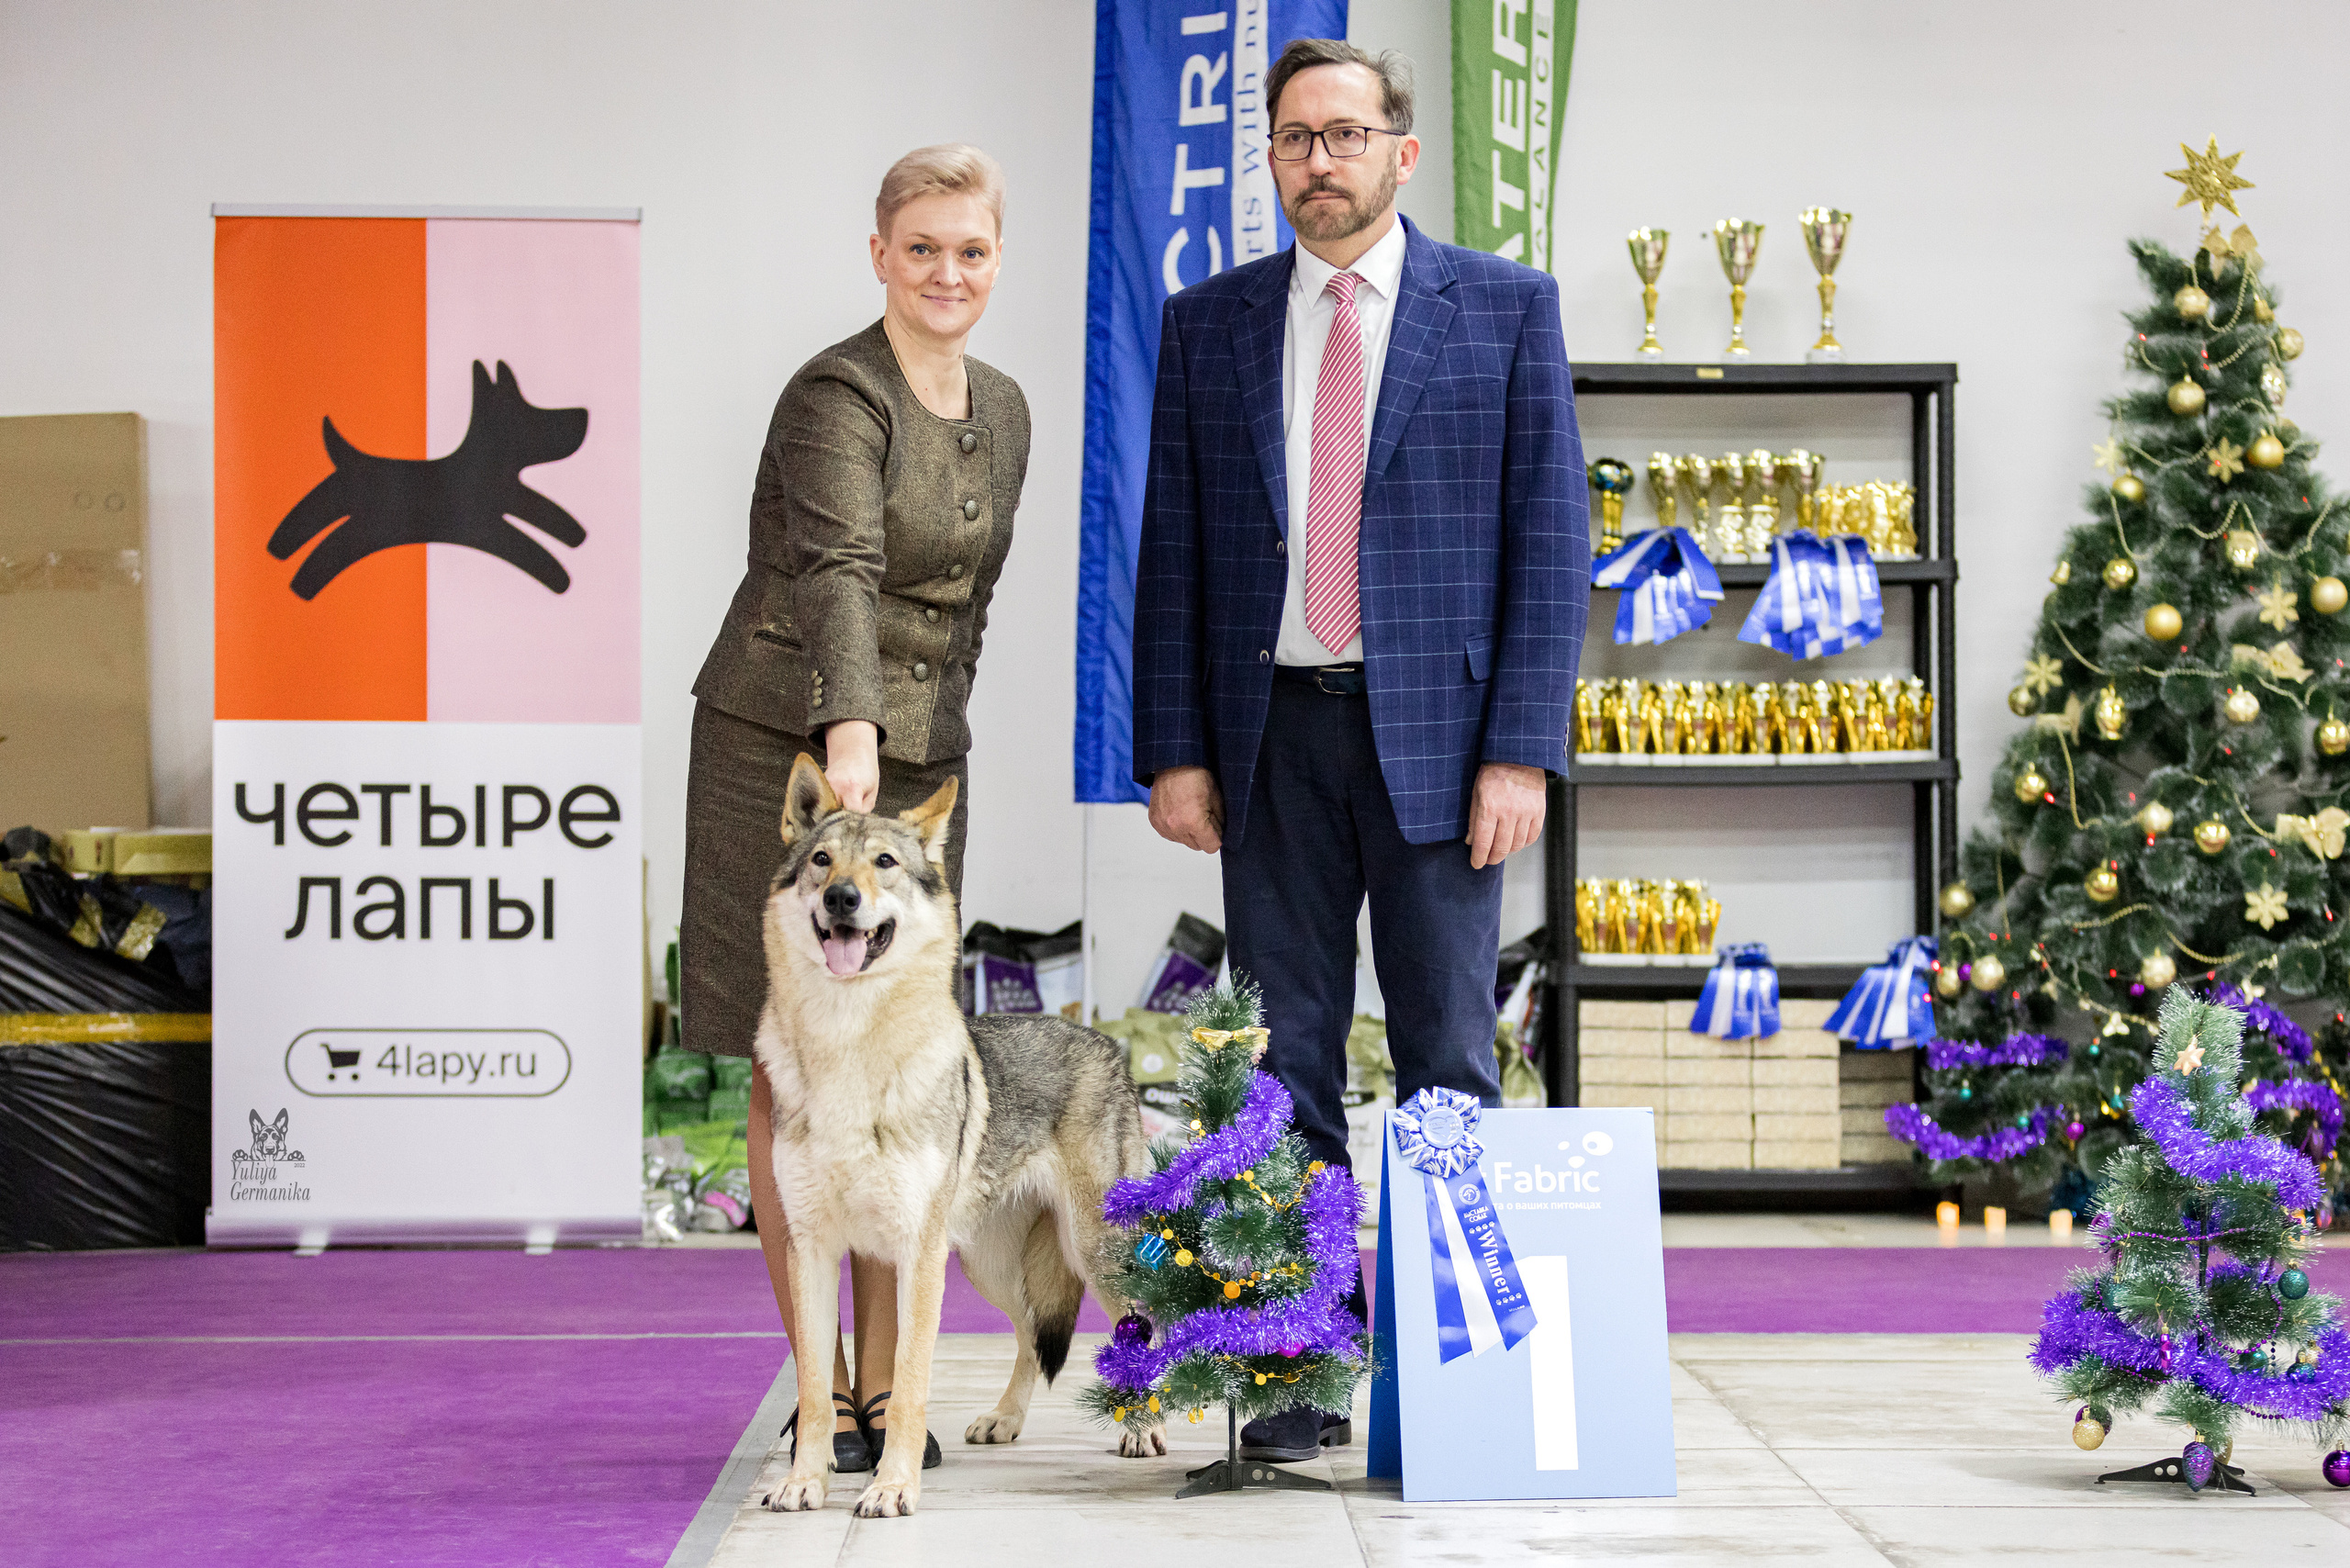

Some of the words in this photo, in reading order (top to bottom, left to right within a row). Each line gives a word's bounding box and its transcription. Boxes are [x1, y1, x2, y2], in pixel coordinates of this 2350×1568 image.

[1237, 72, 1259, 174] with
[233, 781, 621, 849] четыре
[285, 875, 554, 941] лапы
[375, 1044, 537, 1084] 4lapy.ru
[1494, 1158, 1601, 1193] Fabric
[1506, 1202, 1514, 1210] о
[1516, 1202, 1549, 1211] ваших
[1550, 1201, 1602, 1211] питомцах
[1477, 1228, 1511, 1294] Winner
[1515, 1255, 1579, 1471] 1
